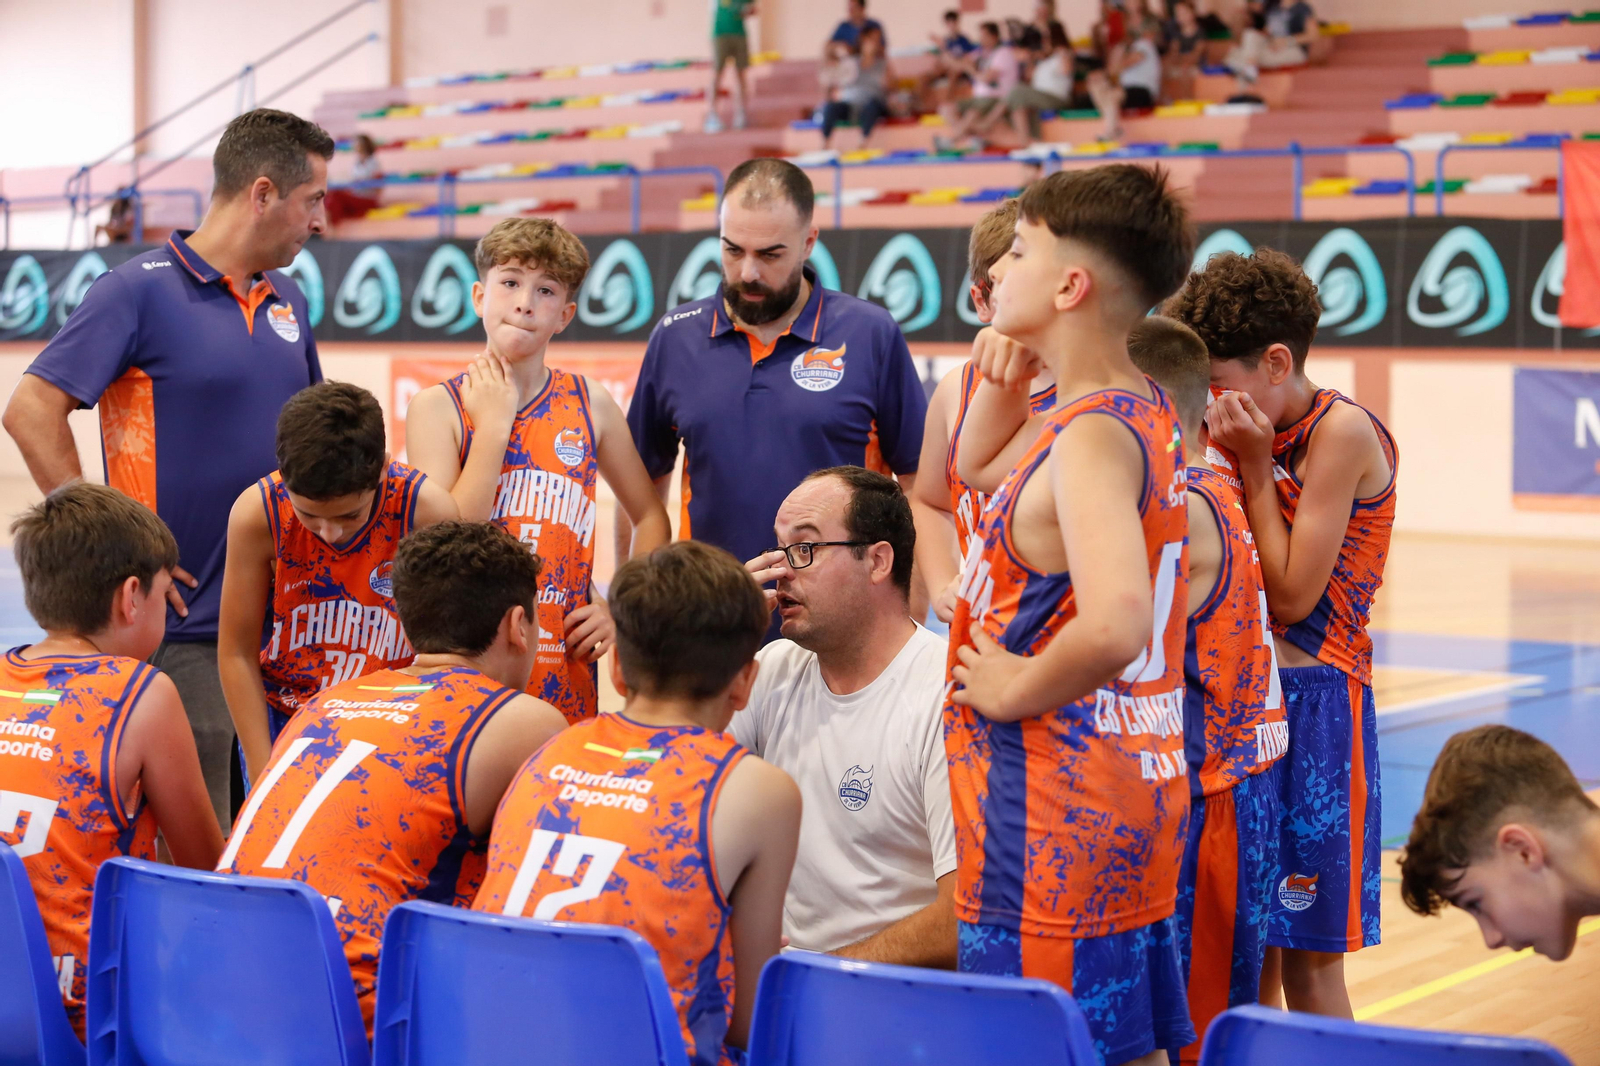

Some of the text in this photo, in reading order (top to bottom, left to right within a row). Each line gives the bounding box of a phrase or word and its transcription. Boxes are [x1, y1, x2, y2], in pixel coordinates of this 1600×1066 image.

[673, 308, 702, 320] Cervi
[795, 370, 839, 380] CHURRIANA
[321, 650, 366, 691] 30
[323, 699, 420, 712] Churriana
[327, 709, 410, 724] Deporte
[1095, 689, 1121, 735] CB
[549, 764, 653, 793] Churriana
[215, 737, 379, 872] 11
[558, 784, 648, 813] Deporte
[502, 828, 627, 921] 12
[1281, 892, 1313, 903] CHURRIANA
